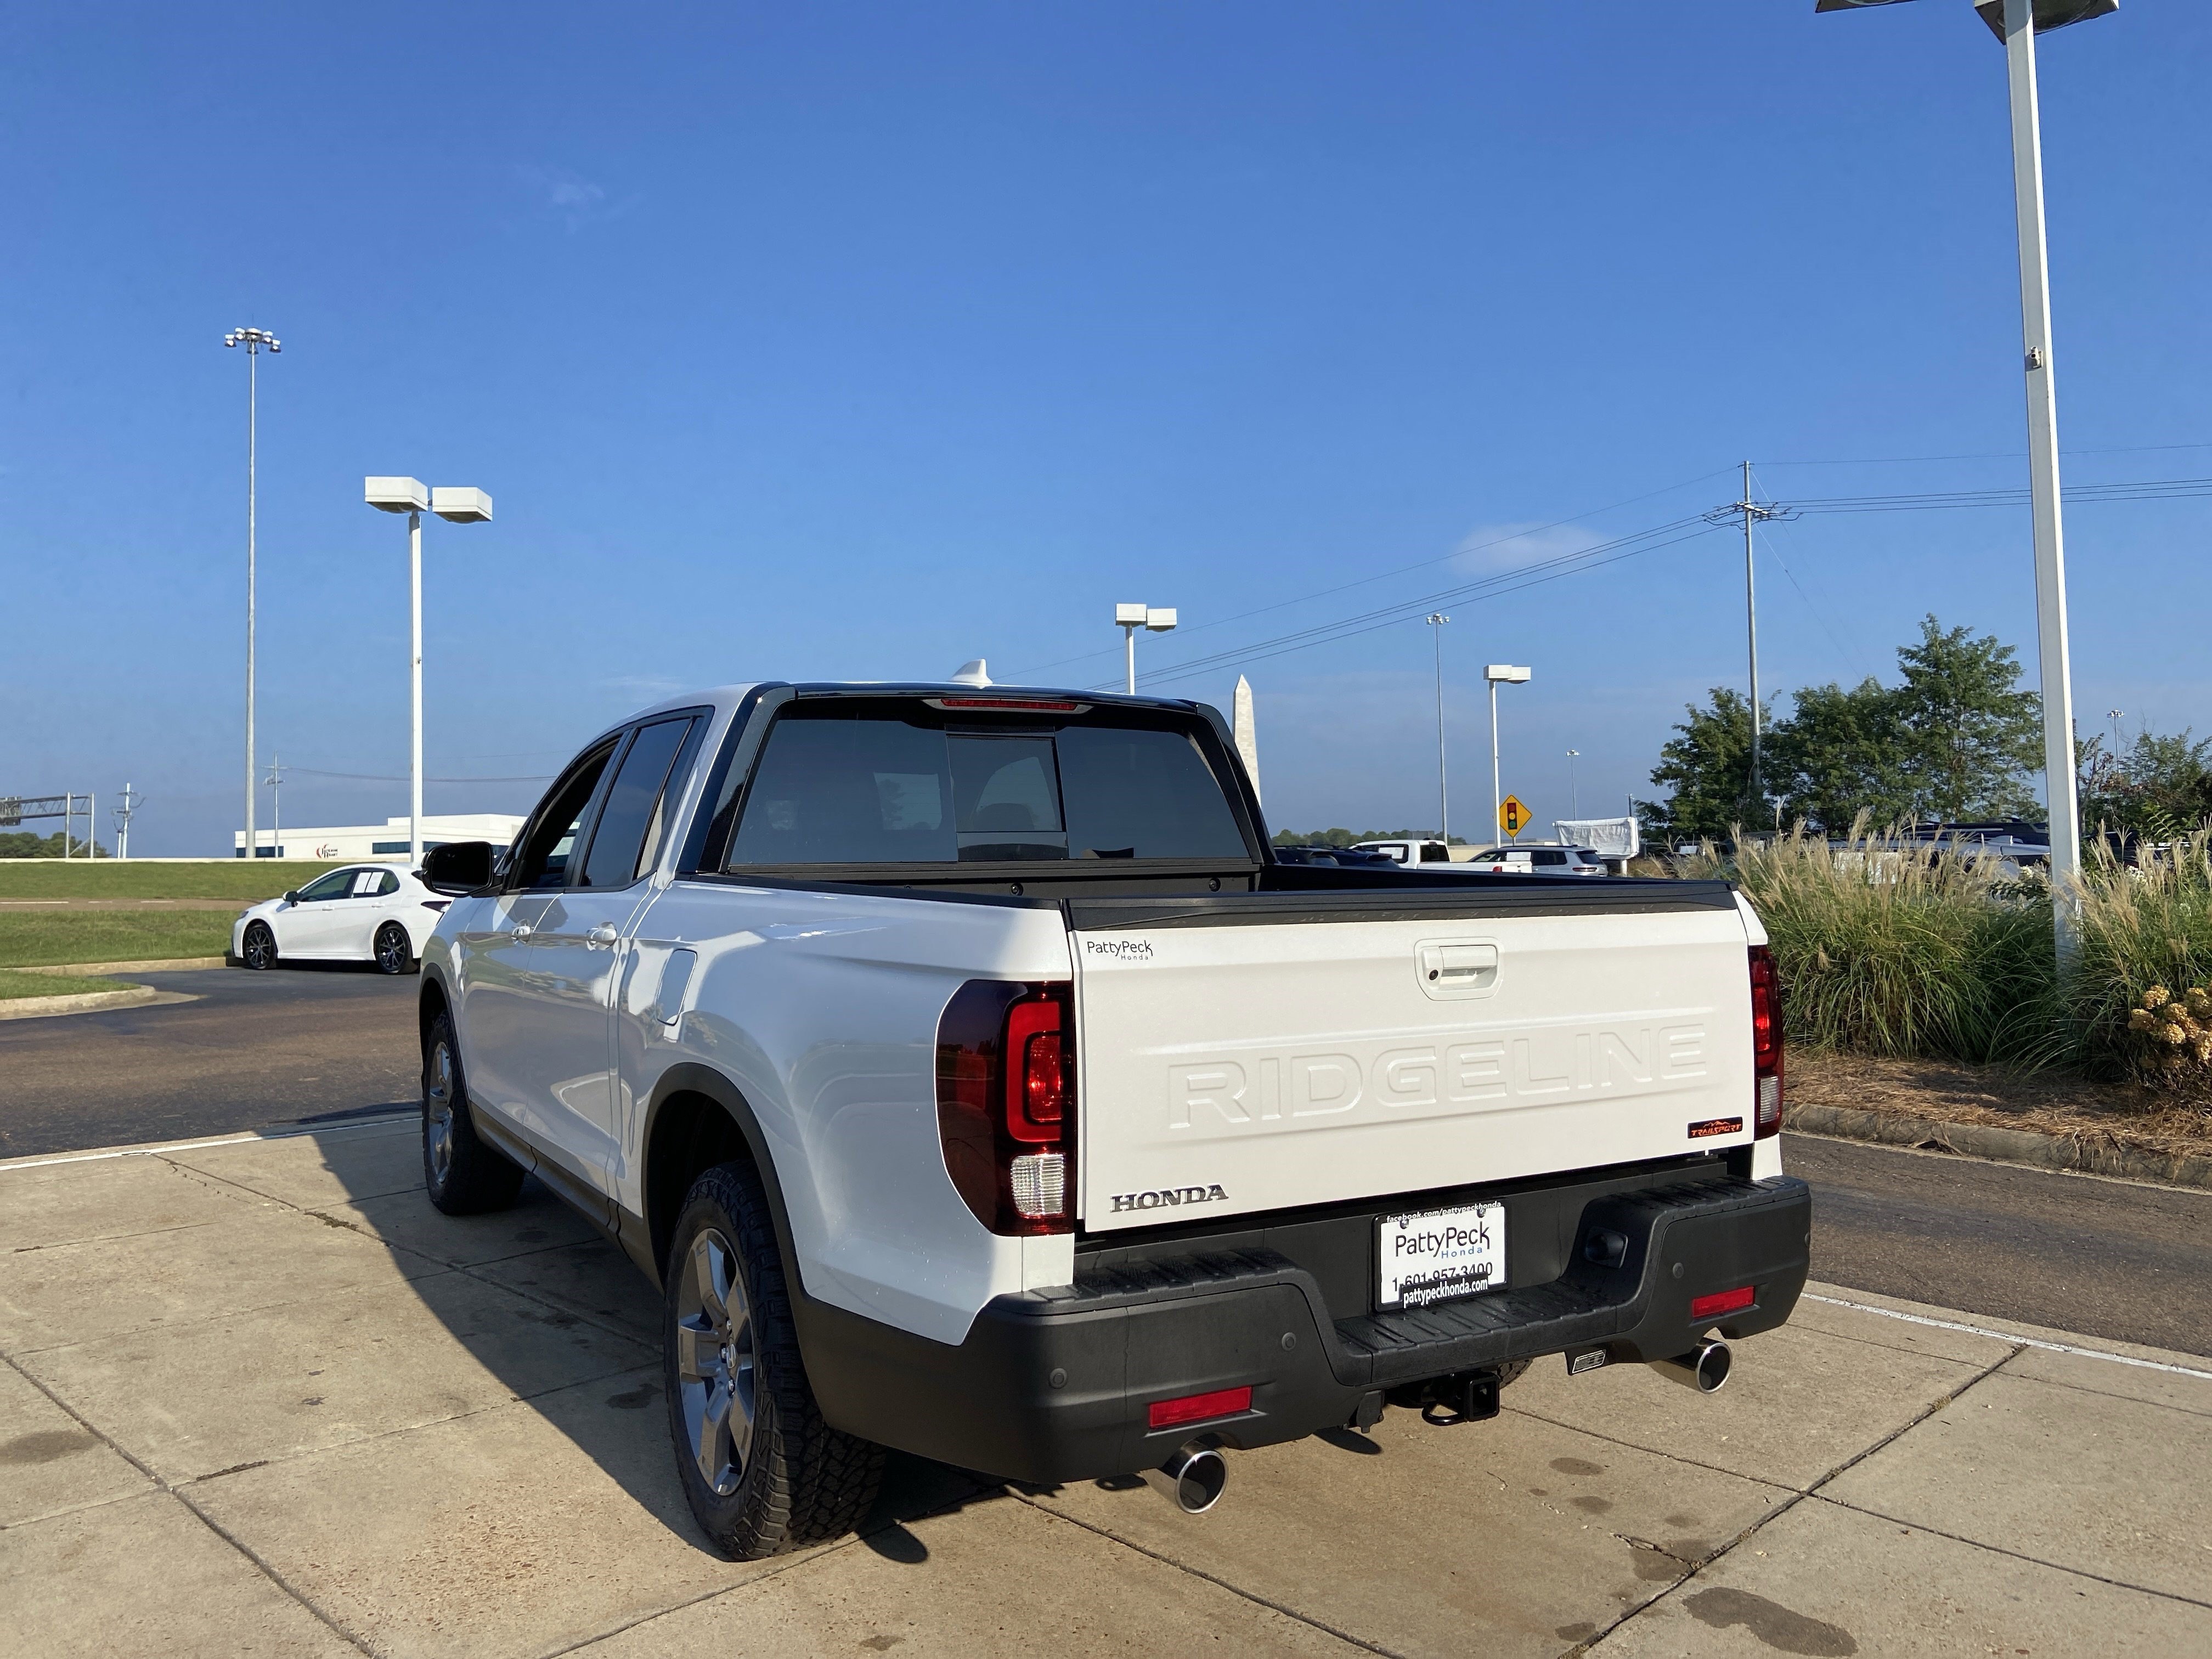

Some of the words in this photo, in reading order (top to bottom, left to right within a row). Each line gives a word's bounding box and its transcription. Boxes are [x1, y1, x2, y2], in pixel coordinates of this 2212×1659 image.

[1087, 940, 1153, 956] PattyPeck
[1168, 1022, 1708, 1128] RIDGELINE
[1691, 1123, 1742, 1136] TRAILSPORT
[1110, 1183, 1229, 1212] HONDA
[1386, 1200, 1501, 1223] facebook.com/pattypeckhonda
[1395, 1221, 1490, 1257] PattyPeck
[1441, 1246, 1482, 1259] Honda
[1403, 1277, 1488, 1309] pattypeckhonda.com
